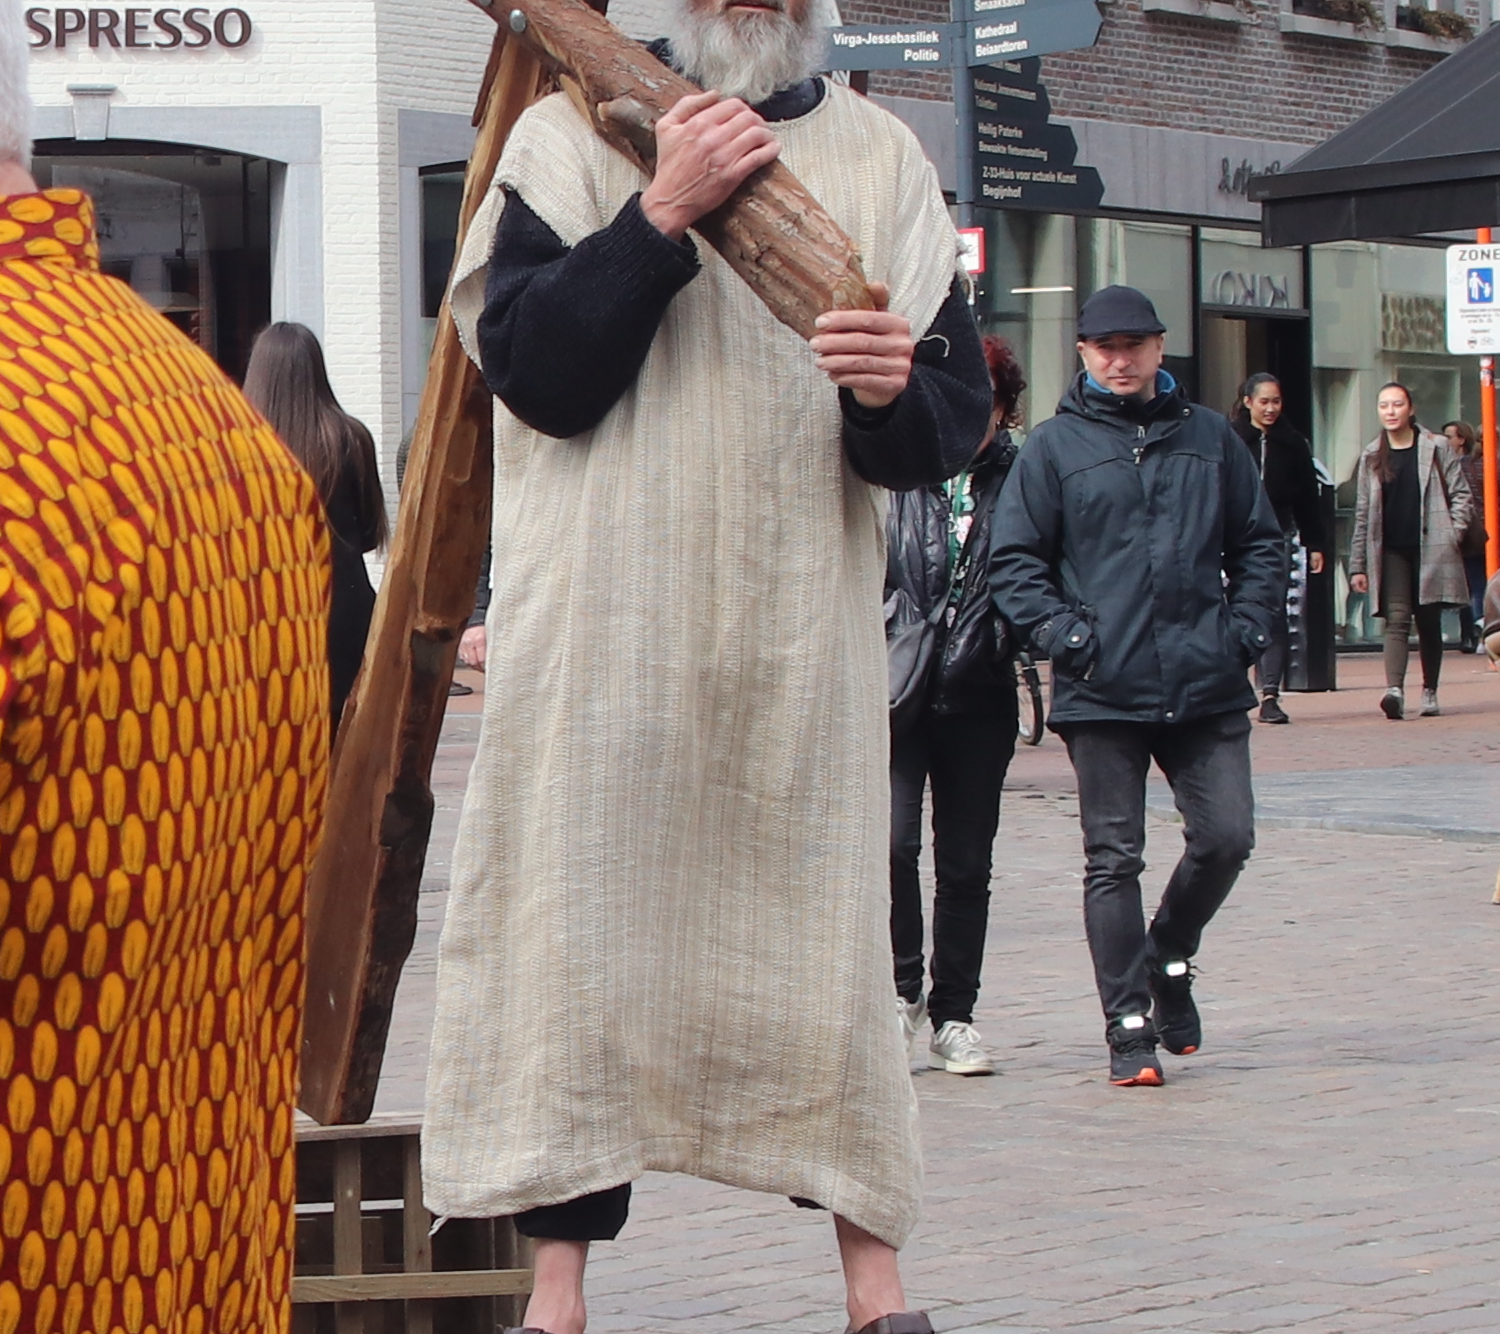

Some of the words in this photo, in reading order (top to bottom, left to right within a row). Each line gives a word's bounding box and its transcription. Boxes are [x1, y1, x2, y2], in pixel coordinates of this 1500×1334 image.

[974, 22, 1018, 40] Kathedraal
[833, 32, 940, 47] Virga-Jessebasiliek
[904, 49, 940, 62] Politie
[975, 39, 1028, 57] Beiaardtoren
[978, 122, 997, 139] Heilig
[1016, 171, 1032, 181] voor
[1056, 171, 1077, 184] Kunst
[982, 184, 1022, 200] Begijnhof
